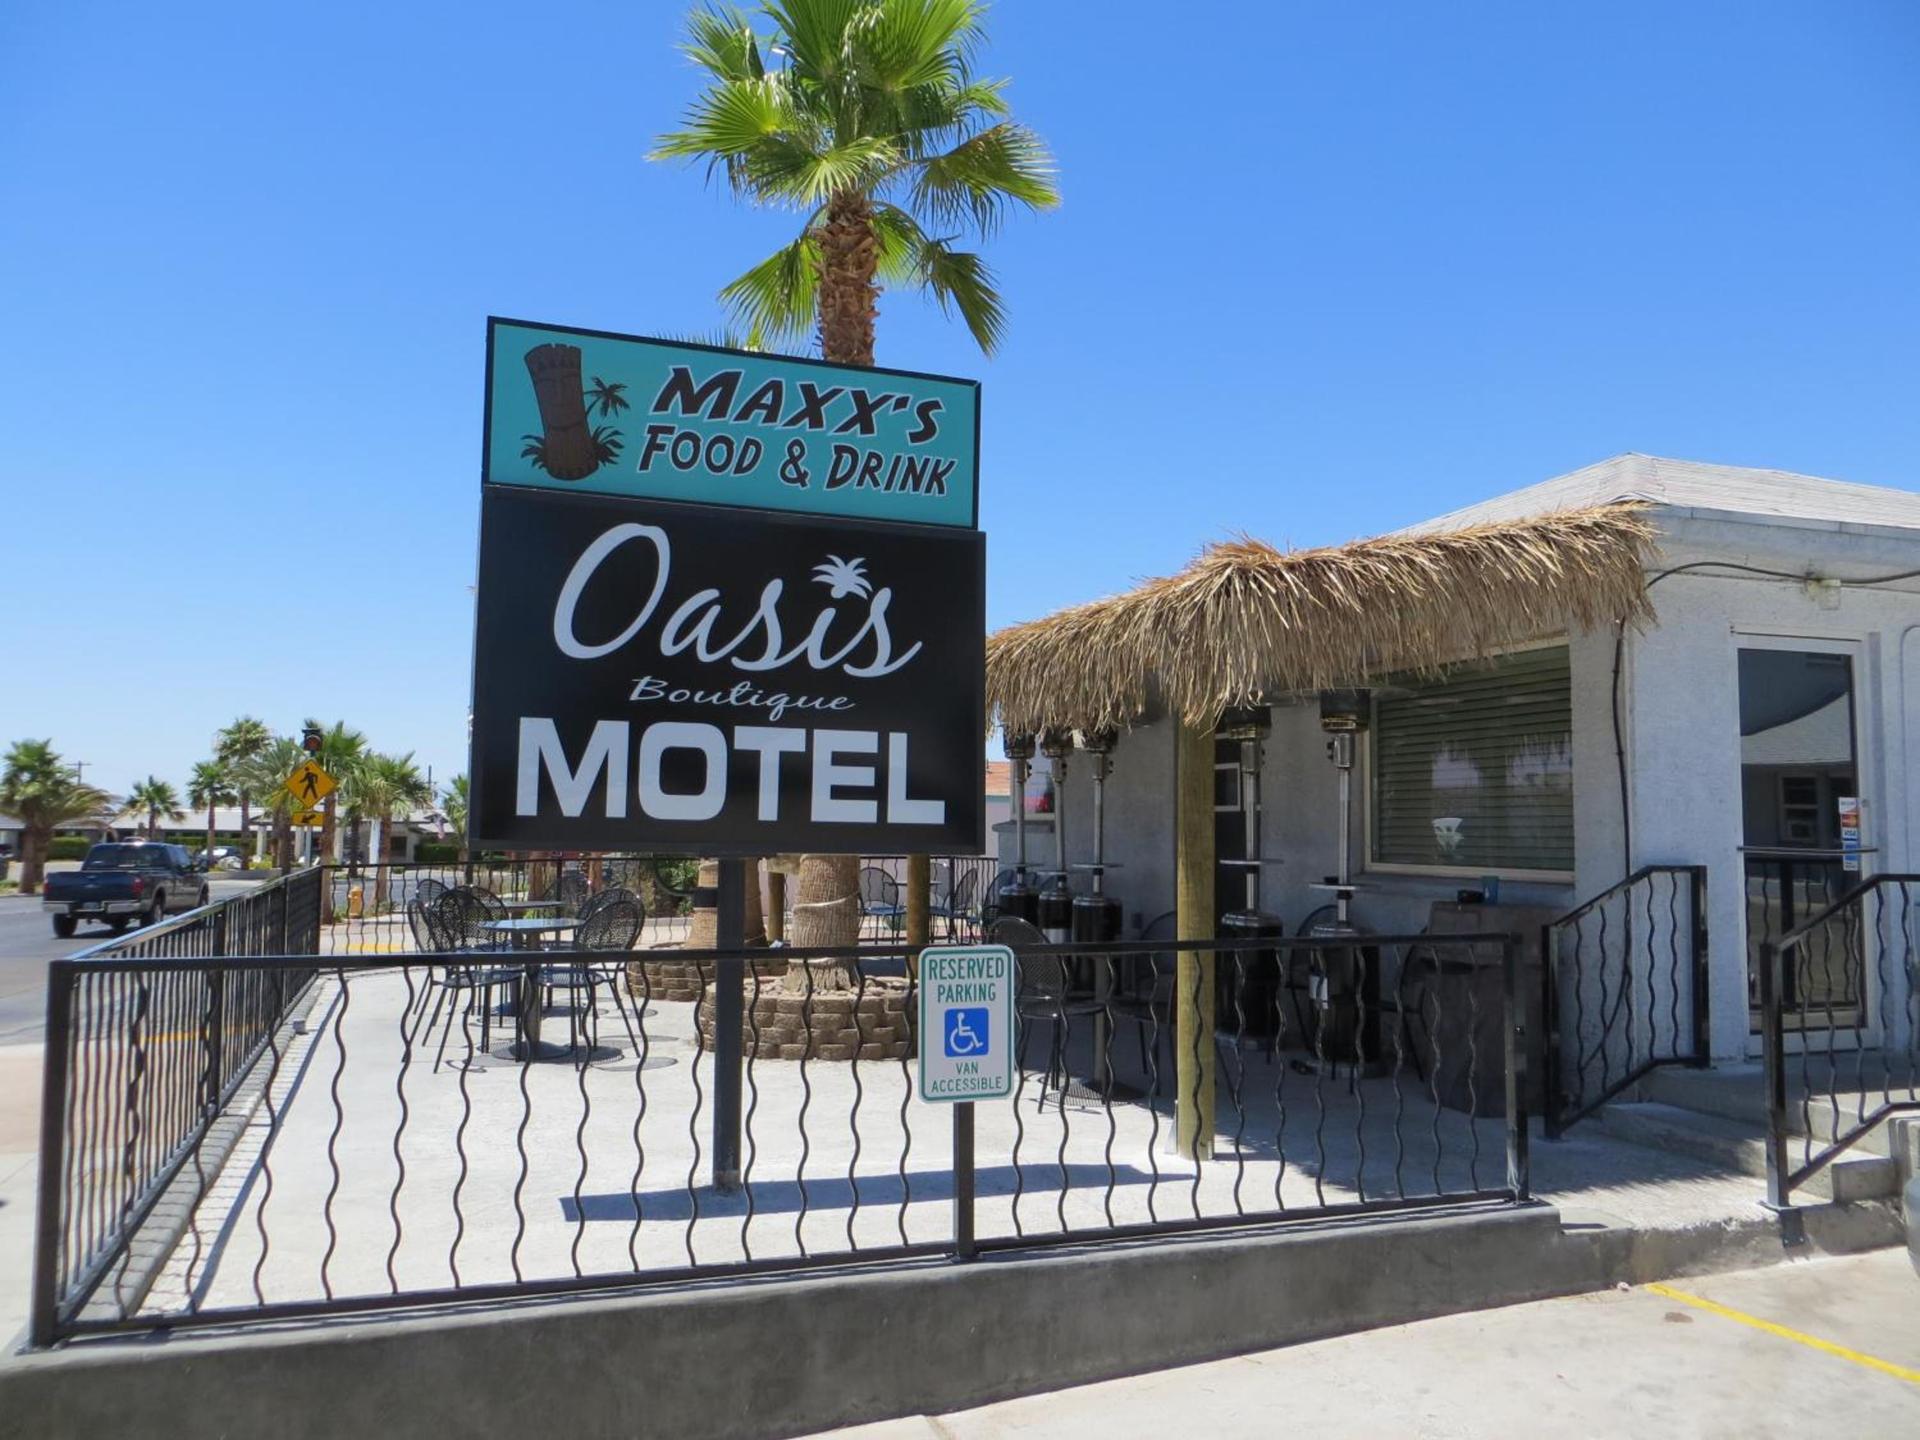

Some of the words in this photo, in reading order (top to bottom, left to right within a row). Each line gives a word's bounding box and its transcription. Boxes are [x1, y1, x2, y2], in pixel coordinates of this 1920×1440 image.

[651, 366, 945, 445] MAXX'S
[638, 424, 763, 476] FOOD
[779, 439, 808, 488] &
[825, 445, 956, 496] DRINK
[553, 522, 923, 678] Oasis
[629, 675, 855, 721] Boutique
[515, 716, 945, 825] MOTEL
[929, 957, 1004, 980] RESERVED
[937, 983, 996, 1003] PARKING
[931, 1076, 1002, 1093] ACCESSIBLE
[956, 1062, 978, 1075] VAN
